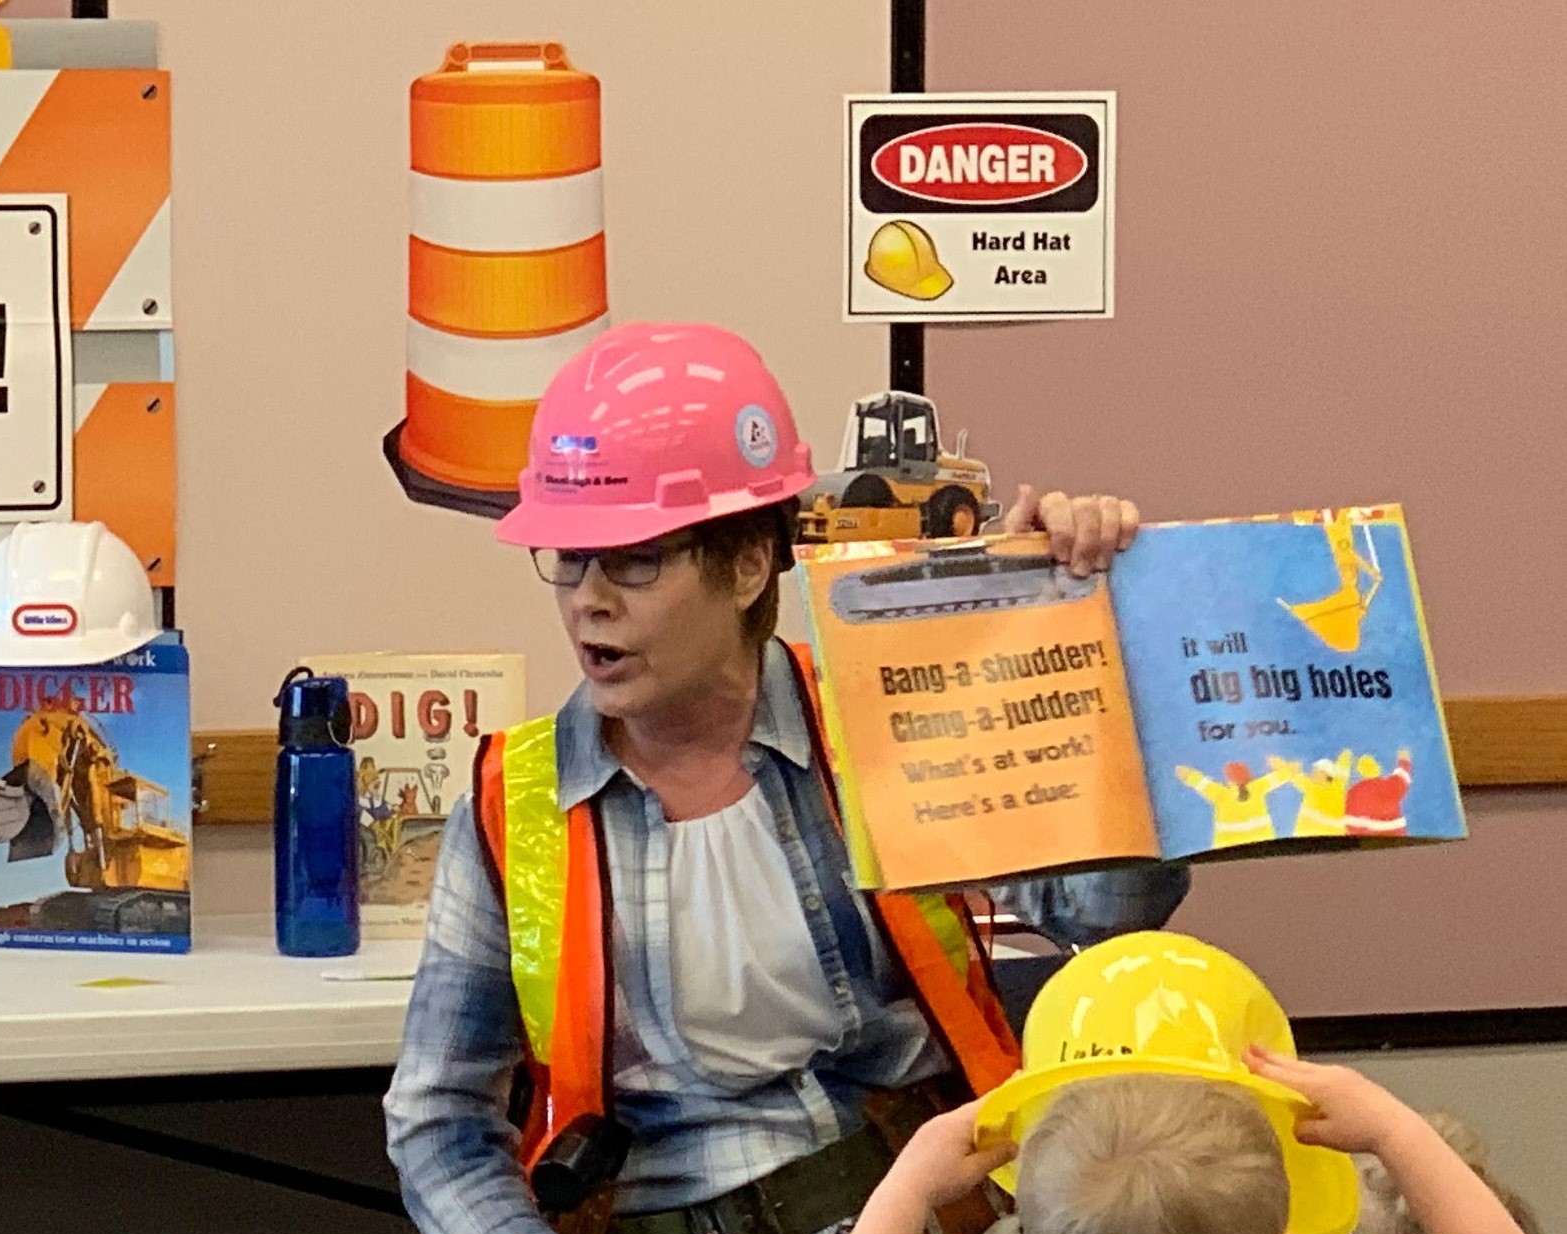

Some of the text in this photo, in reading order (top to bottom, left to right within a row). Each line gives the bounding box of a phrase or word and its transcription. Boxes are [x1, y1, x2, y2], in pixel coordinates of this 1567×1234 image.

[899, 144, 1056, 184] DANGER
[972, 231, 1071, 251] Hard Hat
[994, 265, 1047, 284] Area
[1181, 632, 1248, 657] it will
[880, 640, 1108, 695] Bang-a-shudder!
[1190, 664, 1393, 704] dig big holes
[348, 689, 479, 740] DIG!
[890, 687, 1107, 743] Clang-a-judder!
[1197, 720, 1235, 741] for
[902, 753, 986, 784] What's
[993, 749, 1018, 770] at
[912, 794, 995, 824] Here's
[1002, 793, 1017, 810] a
